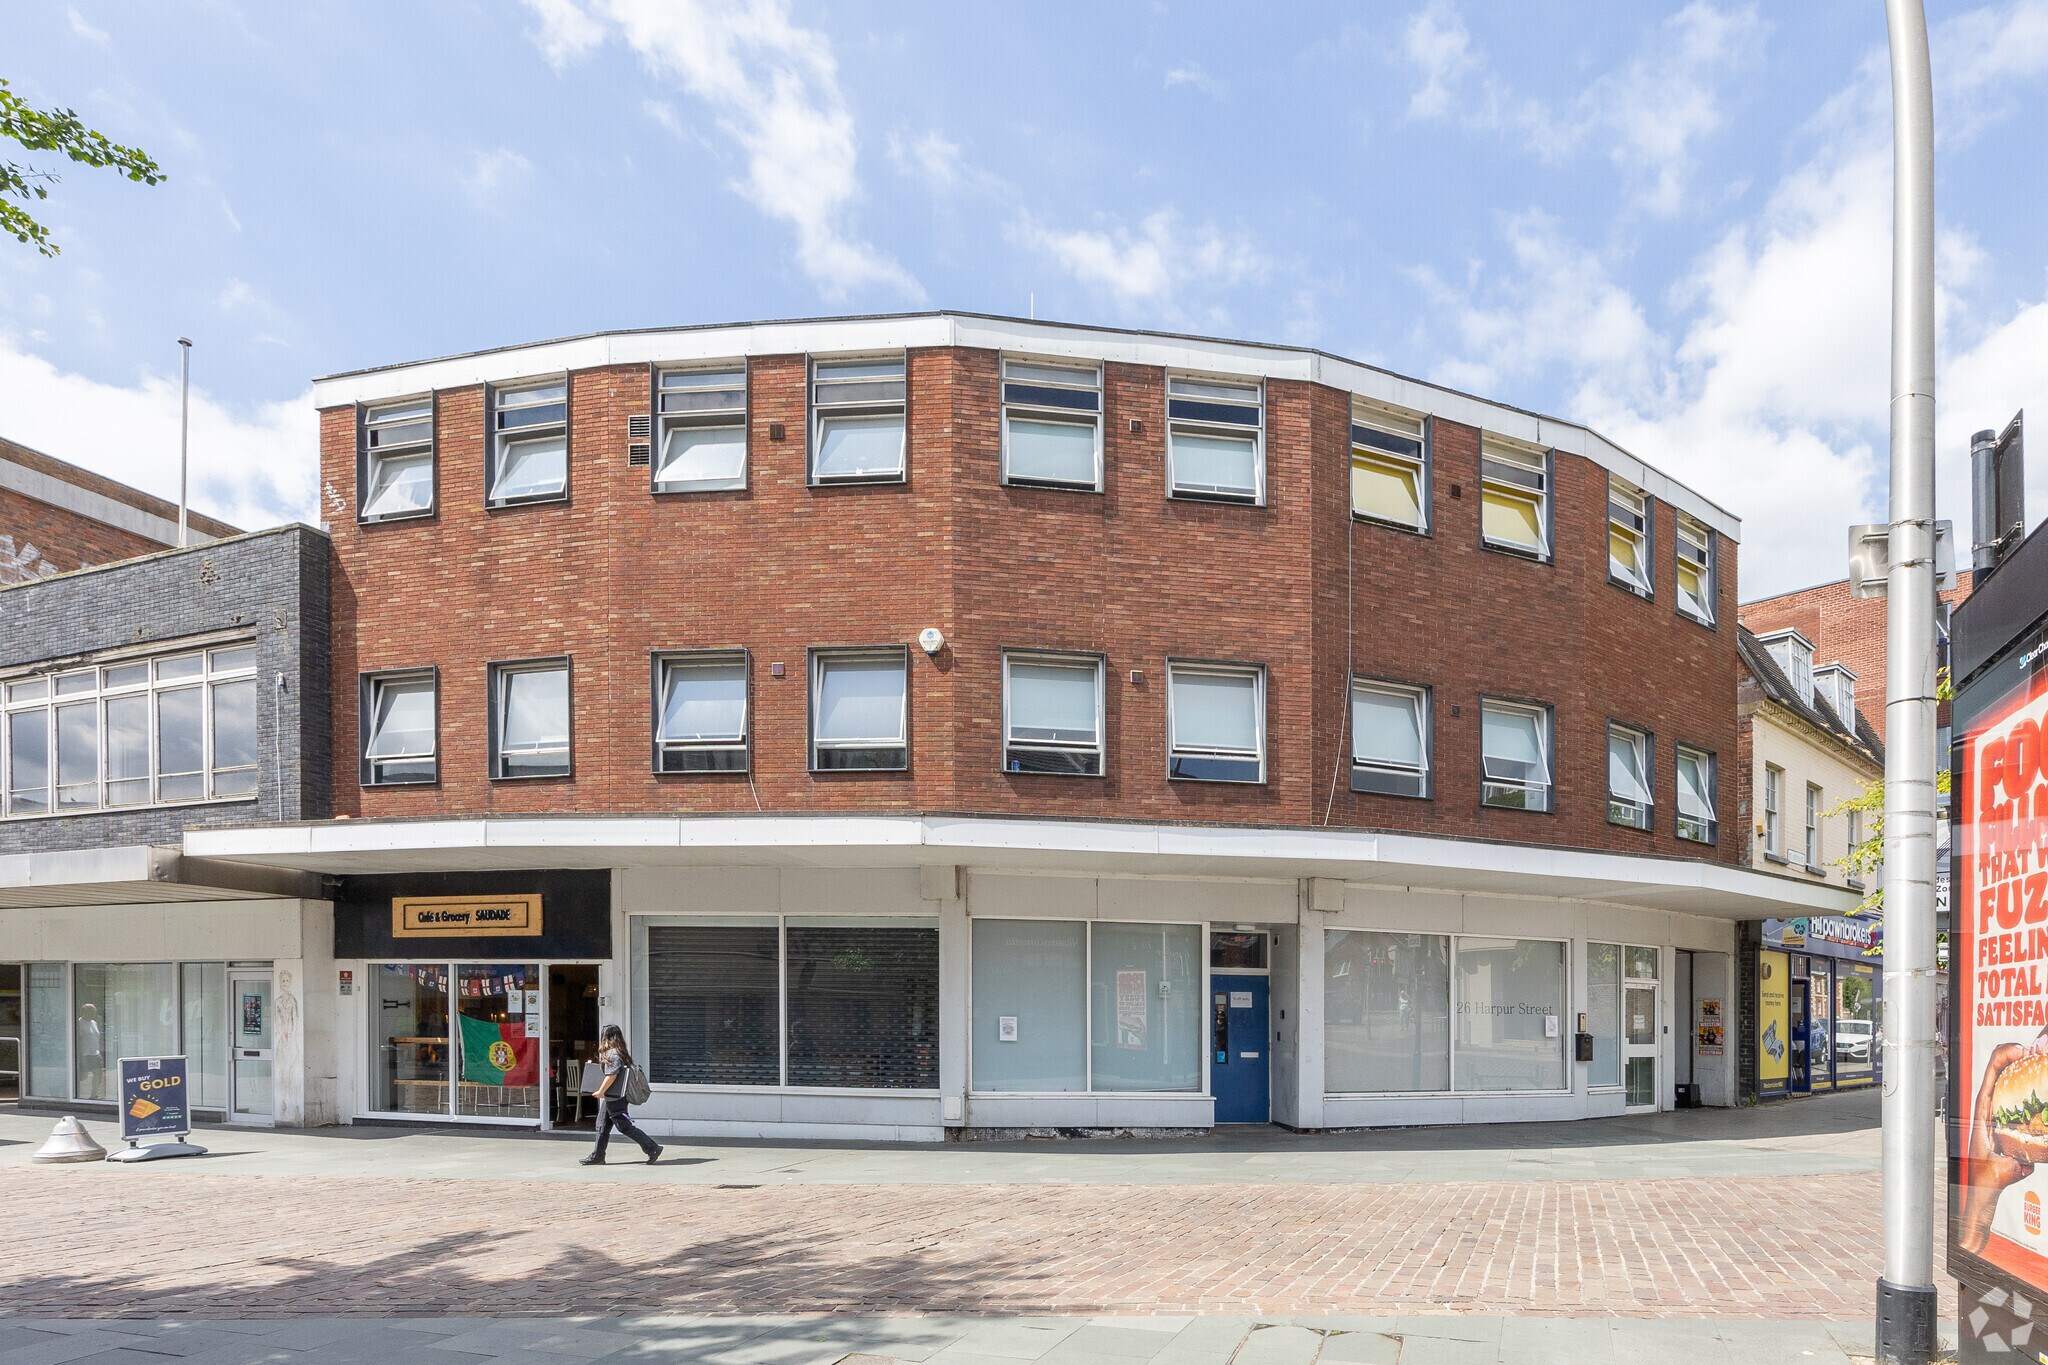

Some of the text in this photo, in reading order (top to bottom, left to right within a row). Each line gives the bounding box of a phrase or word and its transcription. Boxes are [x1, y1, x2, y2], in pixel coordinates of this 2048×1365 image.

[2026, 648, 2039, 663] Clear
[1980, 709, 2048, 813] FO
[1979, 849, 2031, 887] THAT
[441, 910, 471, 925] Grocery
[475, 908, 511, 921] SAUDADE
[1823, 917, 1872, 945] pawnbrokers
[1978, 965, 2042, 999] TOTAL
[1456, 1001, 1553, 1016] 26 Harpur Street
[1977, 1000, 2048, 1027] SATISFA
[140, 1076, 181, 1091] GOLD
[2023, 1202, 2041, 1215] BURGER
[2023, 1210, 2041, 1229] KING
